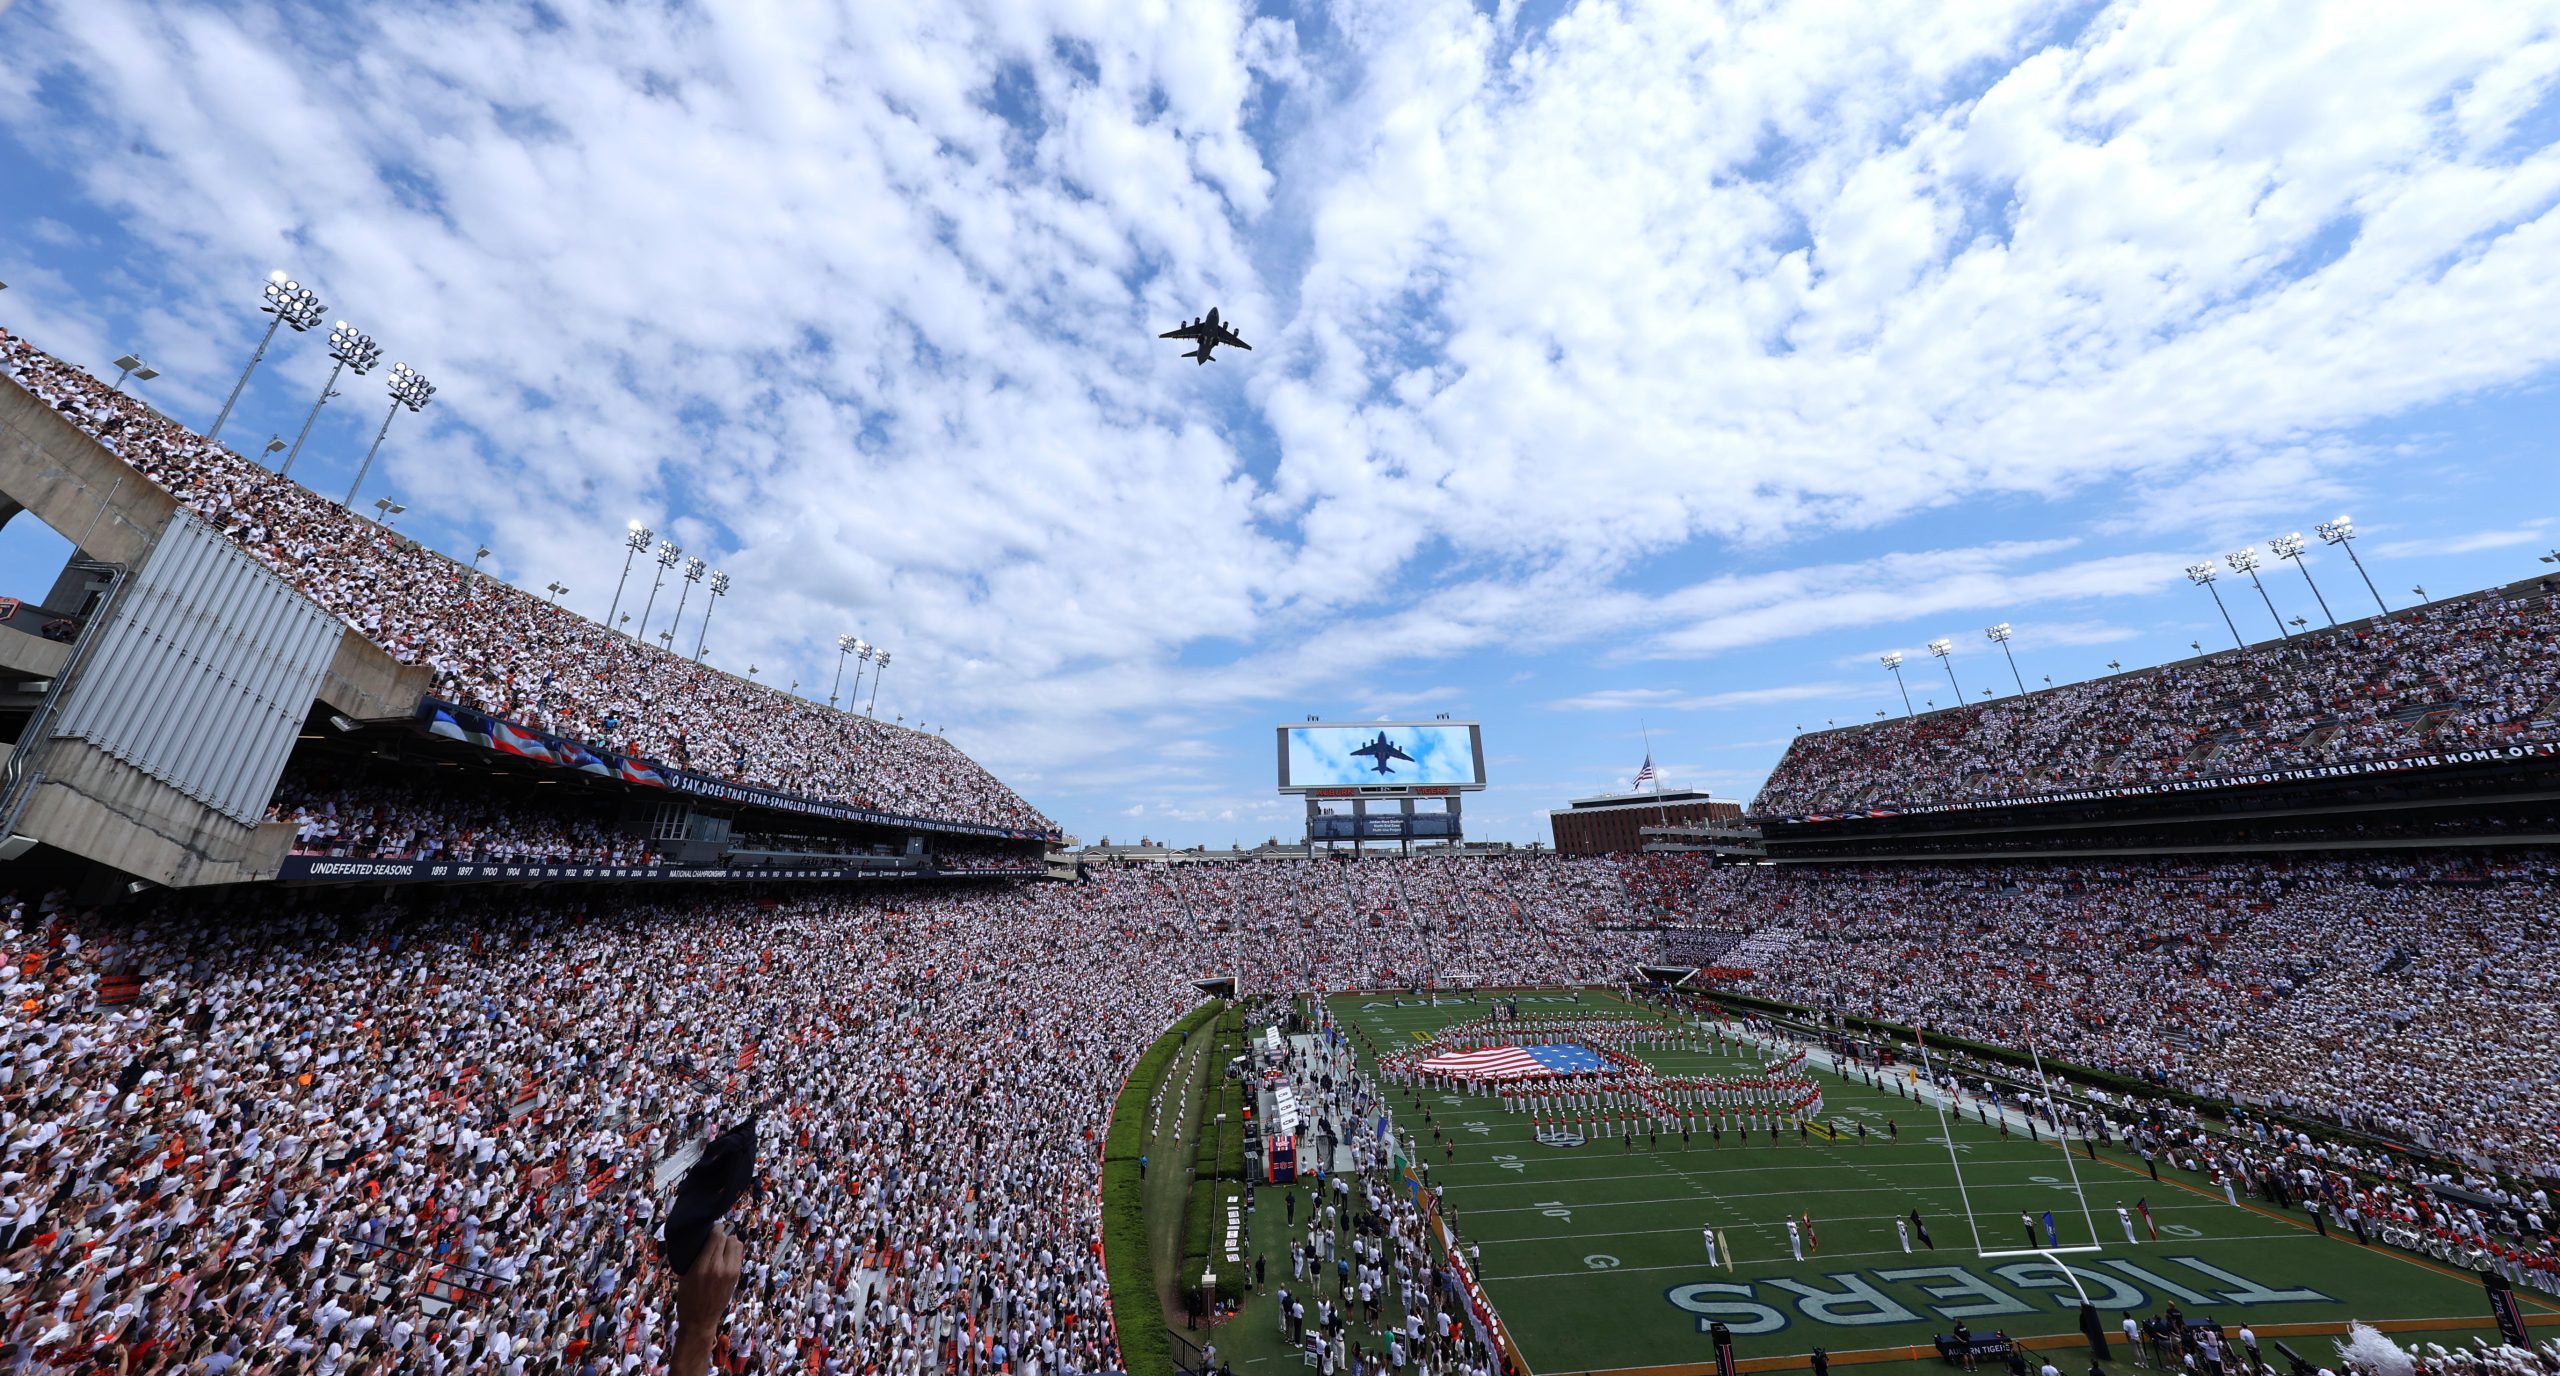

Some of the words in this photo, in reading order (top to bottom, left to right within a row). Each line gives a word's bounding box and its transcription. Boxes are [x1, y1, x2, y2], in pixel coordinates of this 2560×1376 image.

[1910, 806, 1924, 814] SAY
[1928, 804, 1949, 812] DOES
[1951, 802, 1973, 810] THAT
[1975, 796, 2050, 808] STAR-SPANGLED
[2053, 792, 2094, 802] BANNER
[2098, 790, 2118, 798] YET
[2120, 786, 2158, 796] WAVE,
[2161, 782, 2190, 792] O'ER
[2193, 780, 2218, 788] THE
[2221, 775, 2258, 786] LAND
[2262, 772, 2280, 782] OF
[2285, 770, 2315, 780] THE
[2319, 765, 2360, 777] FREE
[2365, 760, 2399, 772] AND
[2404, 756, 2440, 768] THE
[2445, 749, 2502, 764] HOME
[2508, 745, 2536, 757] OF
[1316, 788, 1356, 797] AUBURN
[1415, 786, 1449, 794] TIGERS
[672, 774, 680, 788] O
[682, 777, 700, 792] SAY
[702, 782, 725, 798] DOES
[727, 787, 748, 802] THAT
[748, 792, 806, 812] STAR-SPANGLED
[808, 804, 832, 816] BANNER
[834, 808, 846, 818] YET
[865, 814, 878, 823] O'ER
[880, 816, 890, 824] THE
[890, 818, 904, 826] LAND
[905, 820, 912, 828] OF
[922, 822, 934, 830] FREE
[310, 862, 373, 875] UNDEFEATED
[373, 864, 414, 876] SEASONS
[431, 866, 448, 876] 1893
[457, 866, 473, 876] 1897
[482, 868, 498, 876] 1900
[506, 868, 520, 876] 1904
[528, 868, 540, 876] 1913
[669, 870, 692, 878] NATIONAL
[692, 870, 726, 878] CHAMPIONSHIPS
[1462, 1121, 1491, 1133] 30
[1491, 1154, 1525, 1169] 20
[1534, 1201, 1572, 1217] 10
[1583, 1254, 1620, 1270] G
[1666, 1256, 2338, 1335] TIGERS
